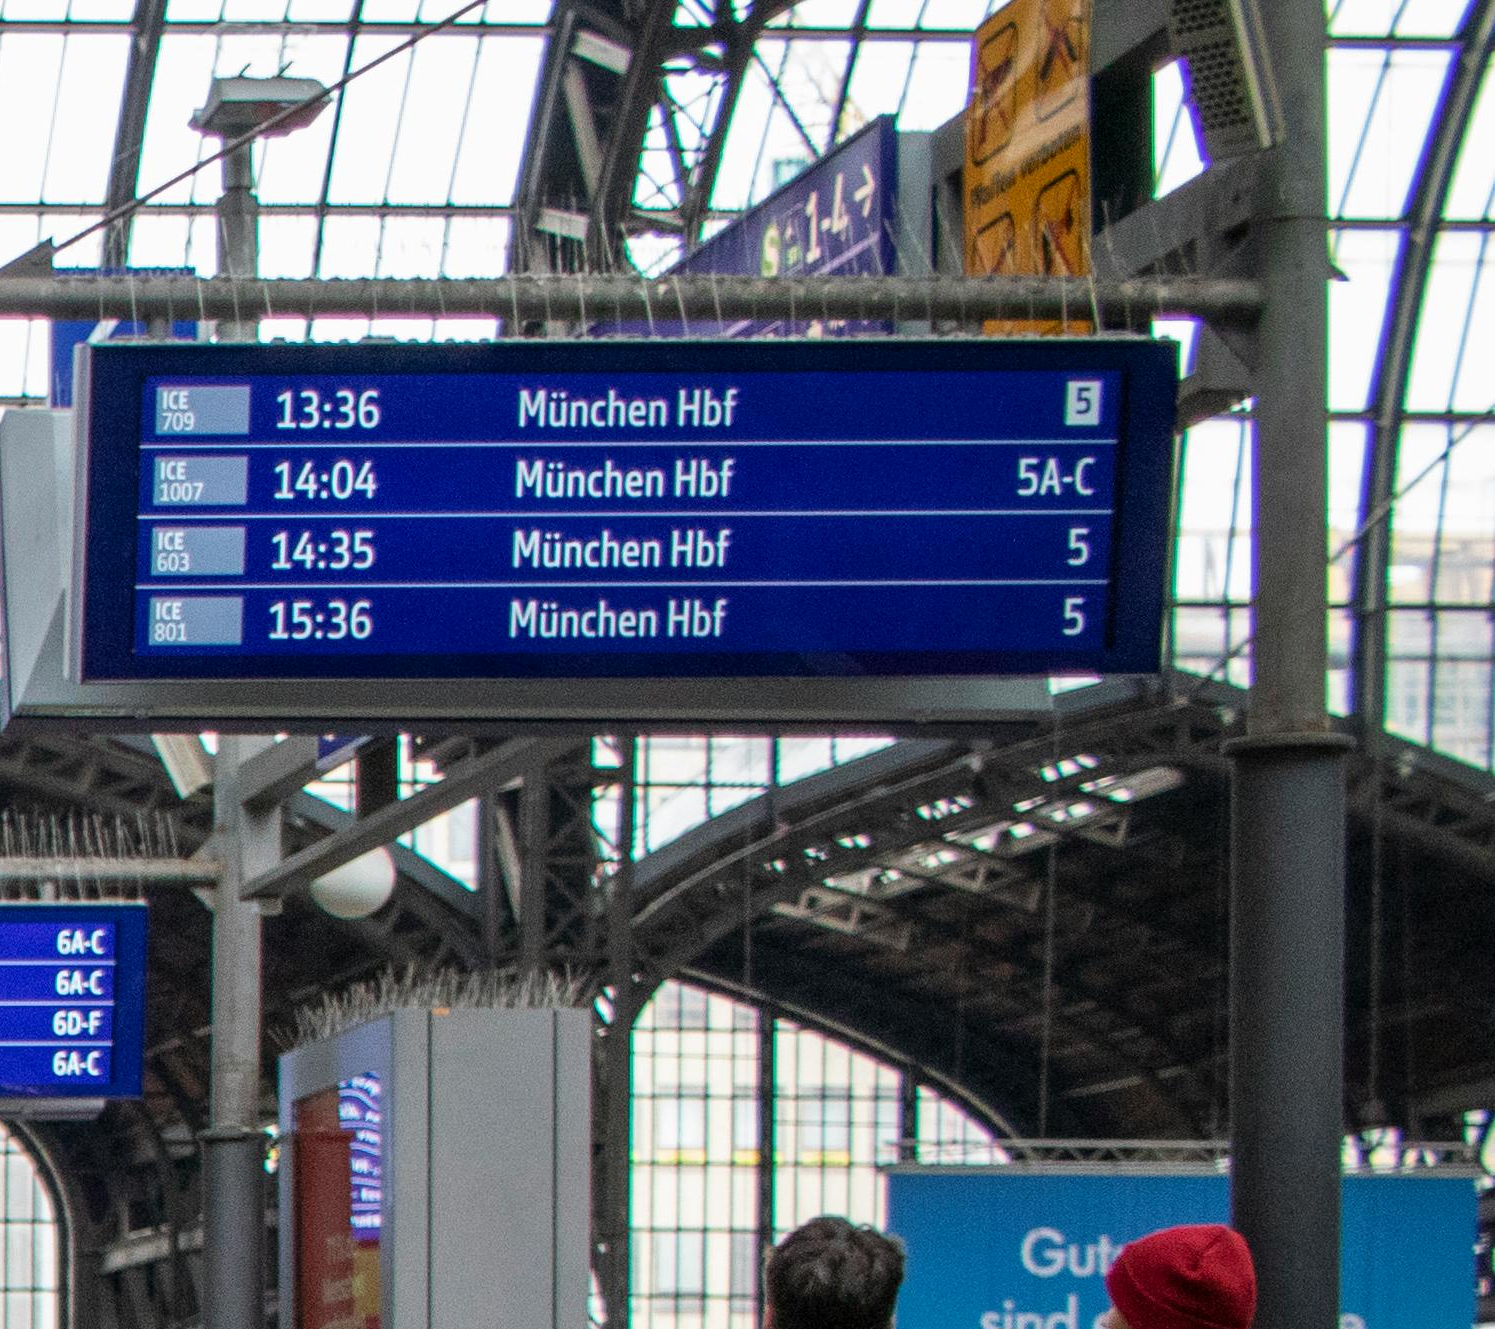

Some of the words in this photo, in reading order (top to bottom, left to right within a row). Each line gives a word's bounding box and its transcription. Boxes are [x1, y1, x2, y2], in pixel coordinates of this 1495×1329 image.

[161, 390, 190, 410] ICE
[275, 389, 381, 430] 13:36
[518, 388, 668, 428] München
[676, 387, 739, 427] Hbf
[1074, 387, 1092, 414] 5
[161, 412, 195, 432] 709
[159, 461, 187, 481] ICE
[273, 460, 377, 500] 14:04
[515, 459, 665, 498] München
[673, 458, 736, 497] Hbf
[1016, 457, 1096, 496] 5A-C
[158, 482, 204, 502] 1007
[157, 531, 185, 551] ICE
[270, 530, 375, 570] 14:35
[512, 529, 661, 568] München
[670, 528, 732, 567] Hbf
[1066, 527, 1089, 566] 5
[156, 552, 190, 572] 603
[154, 601, 183, 621] ICE
[268, 600, 373, 640] 15:36
[508, 599, 658, 638] München
[667, 598, 729, 637] Hbf
[1061, 597, 1085, 635] 5
[153, 622, 188, 642] 801
[56, 929, 106, 955] 6A-C
[55, 969, 104, 996] 6A-C
[52, 1010, 103, 1036] 6D-F
[52, 1050, 102, 1077] 6A-C
[1020, 1226, 1123, 1278] Gut
